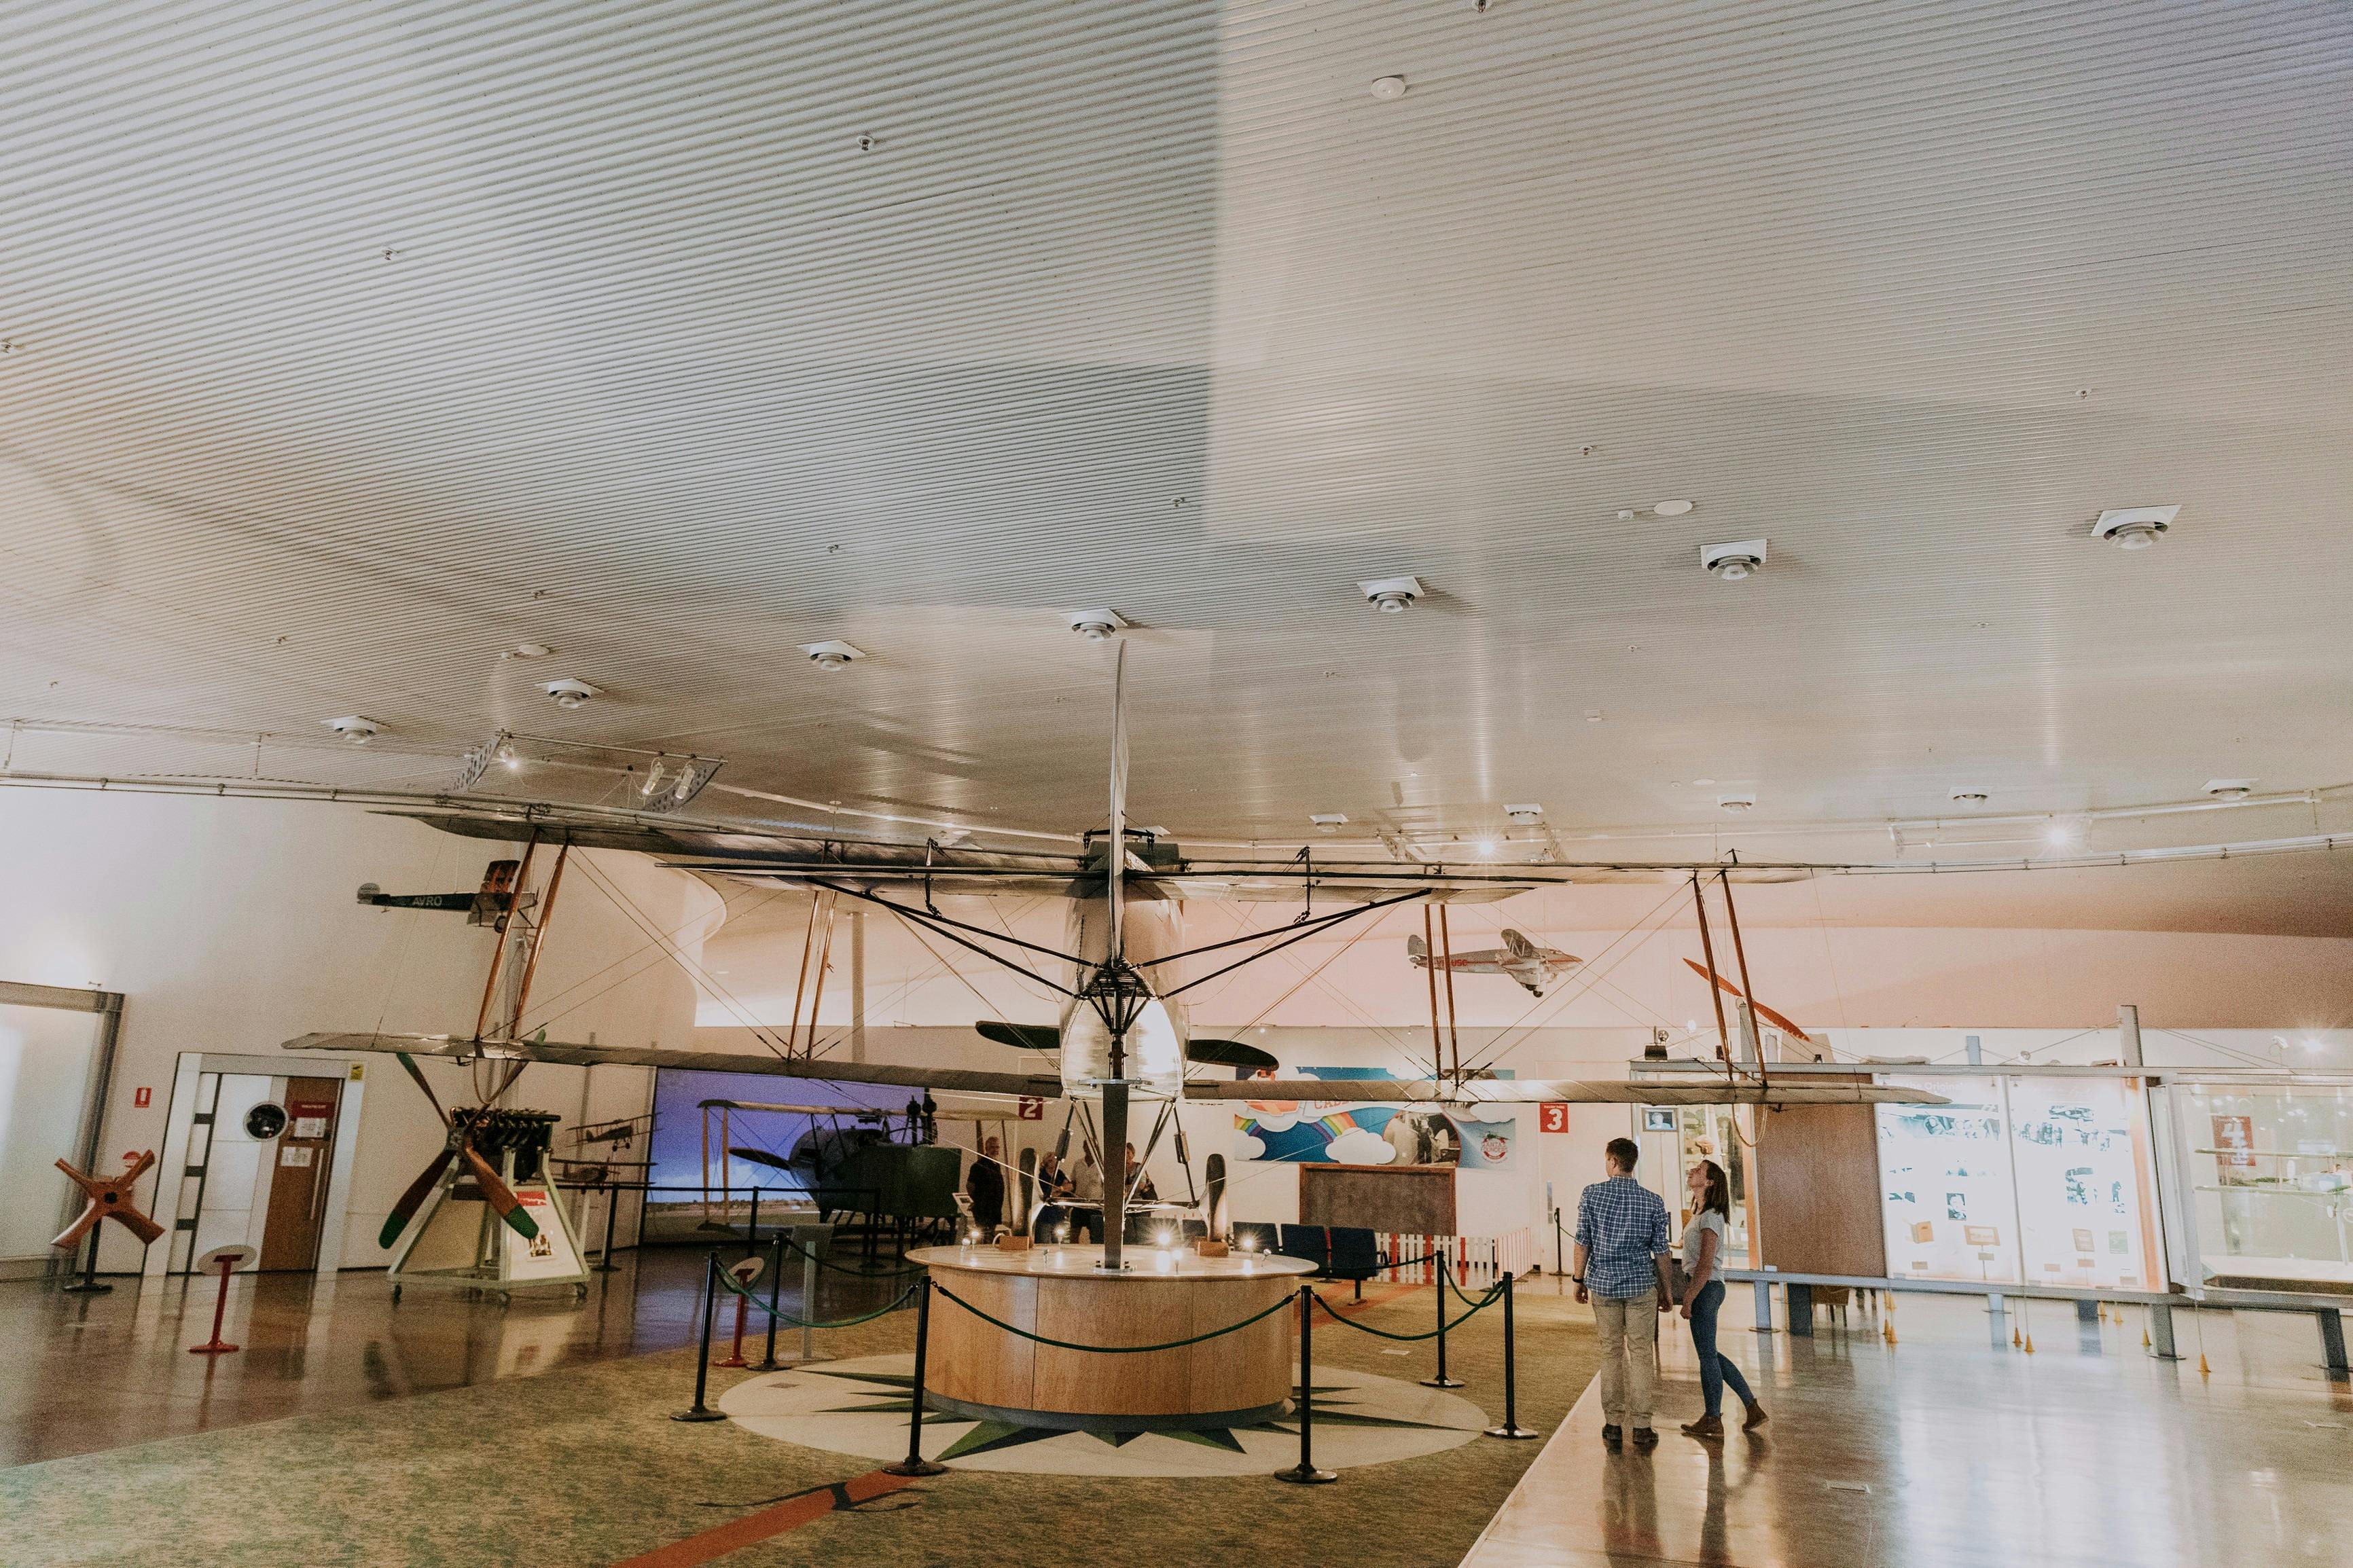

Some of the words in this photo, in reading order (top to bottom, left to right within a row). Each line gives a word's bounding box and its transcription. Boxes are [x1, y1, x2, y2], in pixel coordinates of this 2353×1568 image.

[412, 896, 442, 907] AVRO
[1024, 1098, 1038, 1118] 2
[1547, 1108, 1563, 1131] 3
